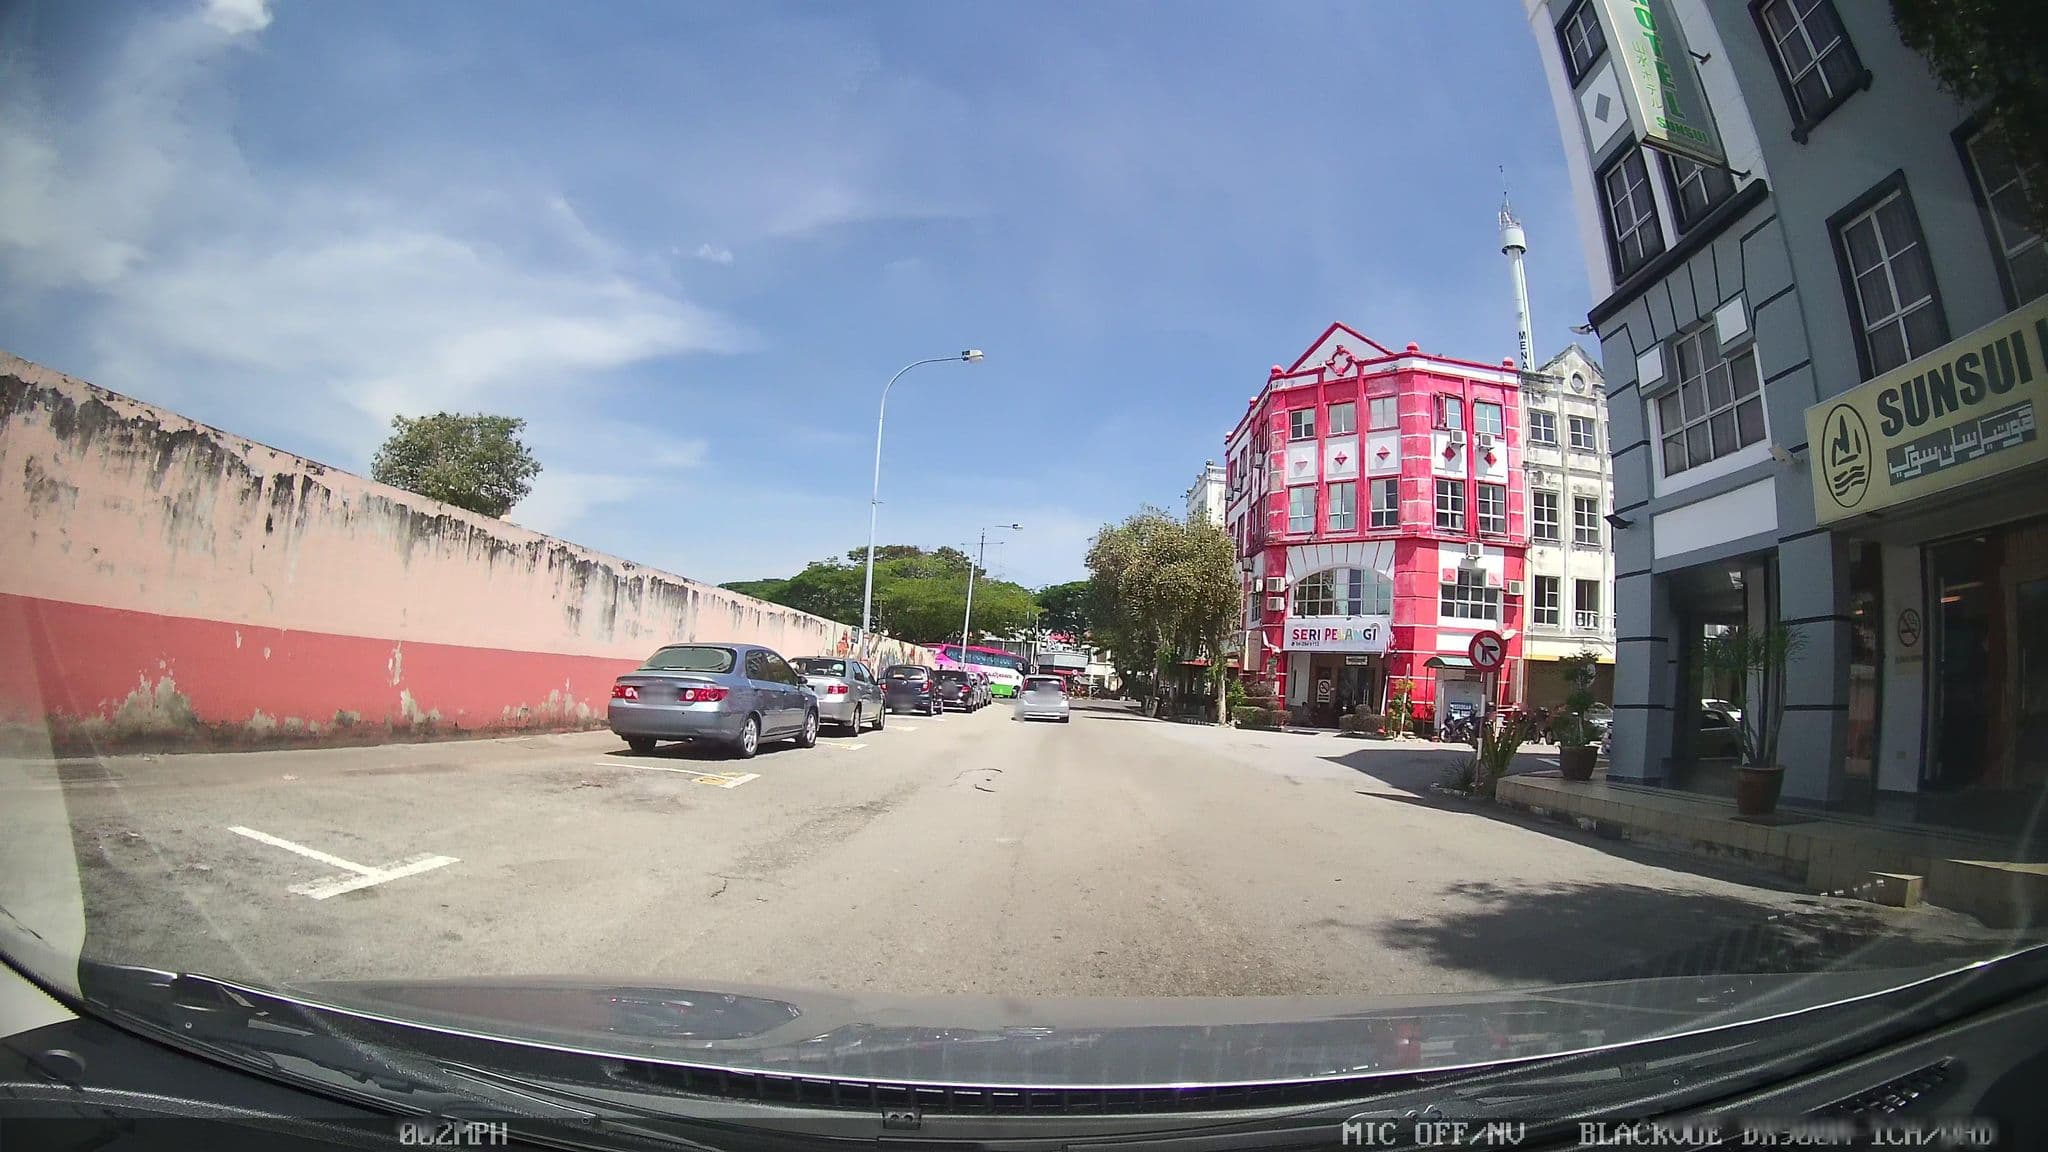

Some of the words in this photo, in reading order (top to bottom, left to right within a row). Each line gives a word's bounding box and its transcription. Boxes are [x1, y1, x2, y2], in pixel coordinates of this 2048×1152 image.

[1630, 0, 1686, 119] OTEL
[1656, 117, 1708, 143] SUNSUI
[1877, 329, 2034, 437] SUNSUI
[1292, 628, 1320, 641] SERI
[1324, 627, 1377, 641] PELANGI
